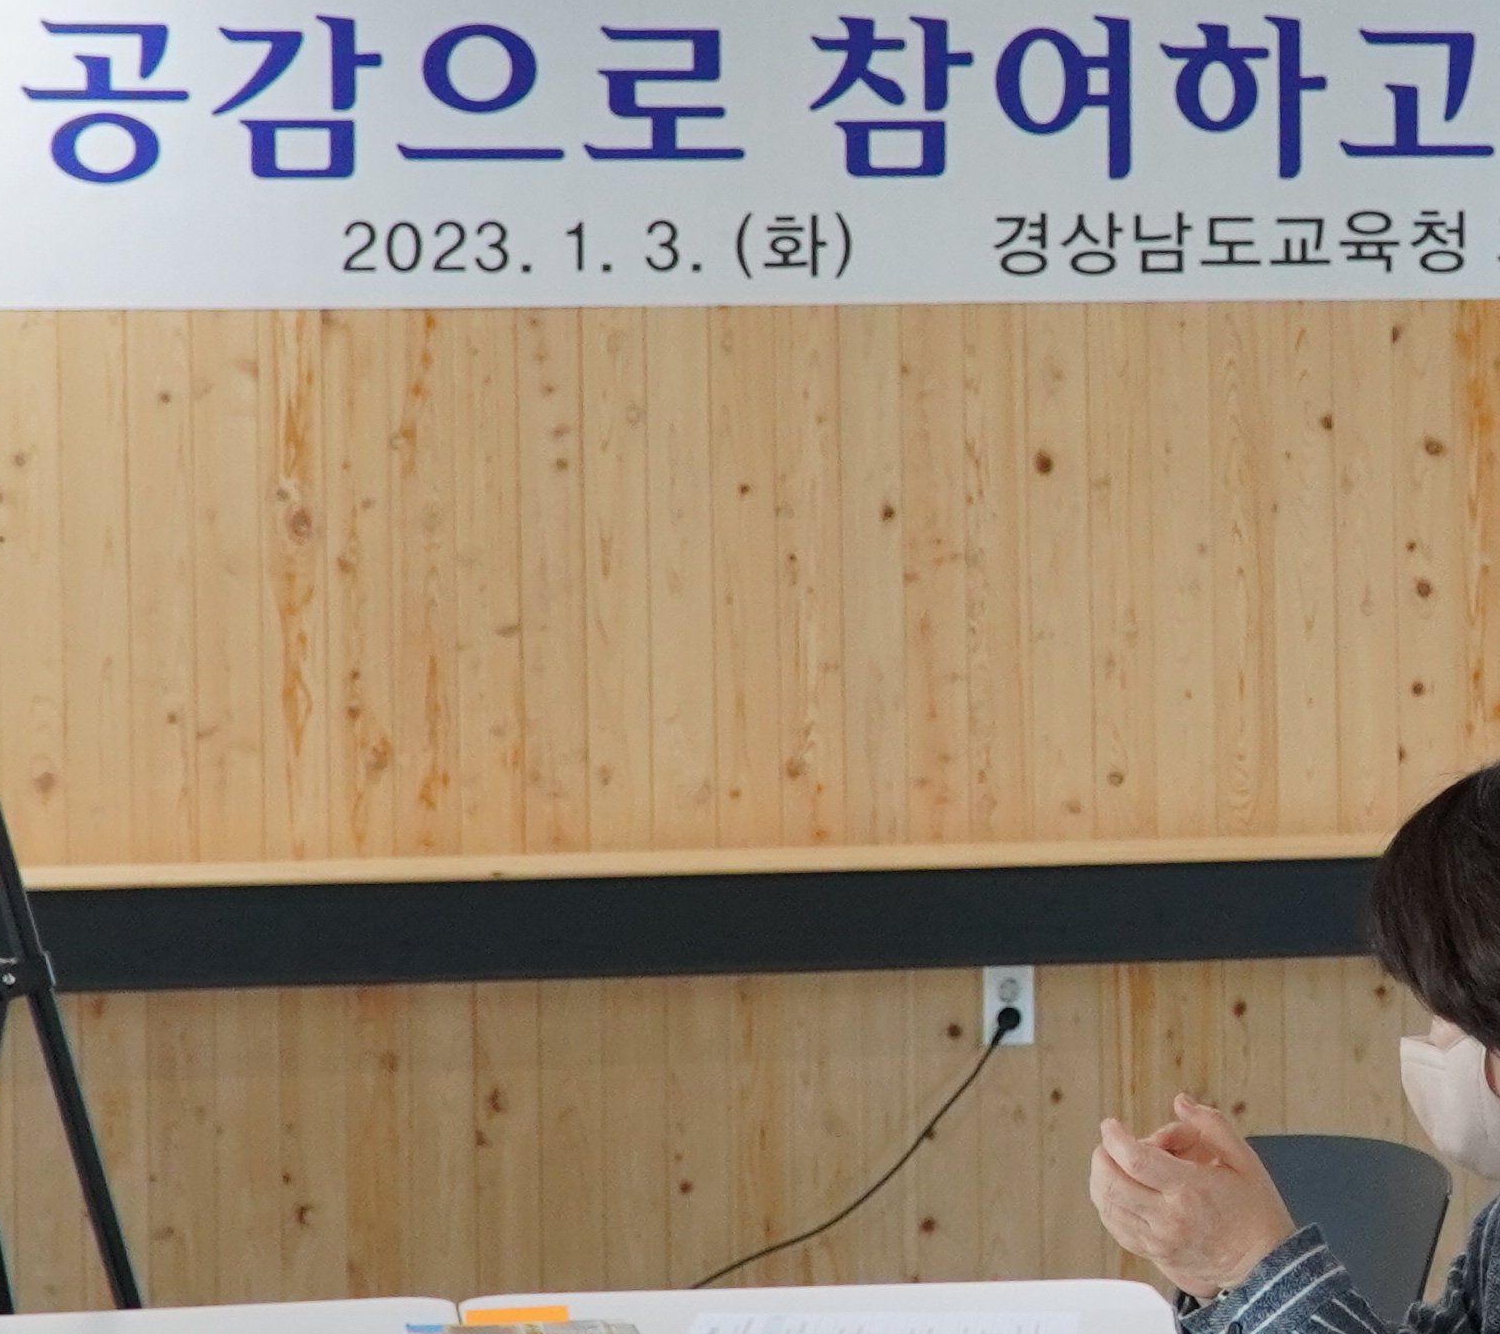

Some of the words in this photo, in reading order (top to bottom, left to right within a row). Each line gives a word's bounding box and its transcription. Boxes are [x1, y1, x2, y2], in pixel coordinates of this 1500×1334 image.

[23, 14, 746, 184] 공감으로
[809, 14, 1495, 181] 참여하고
[342, 220, 533, 274] 2023.
[566, 221, 612, 273] 1.
[645, 219, 703, 273] 3.
[735, 212, 853, 279] (화)
[994, 210, 1470, 277] 경상남도교육청
